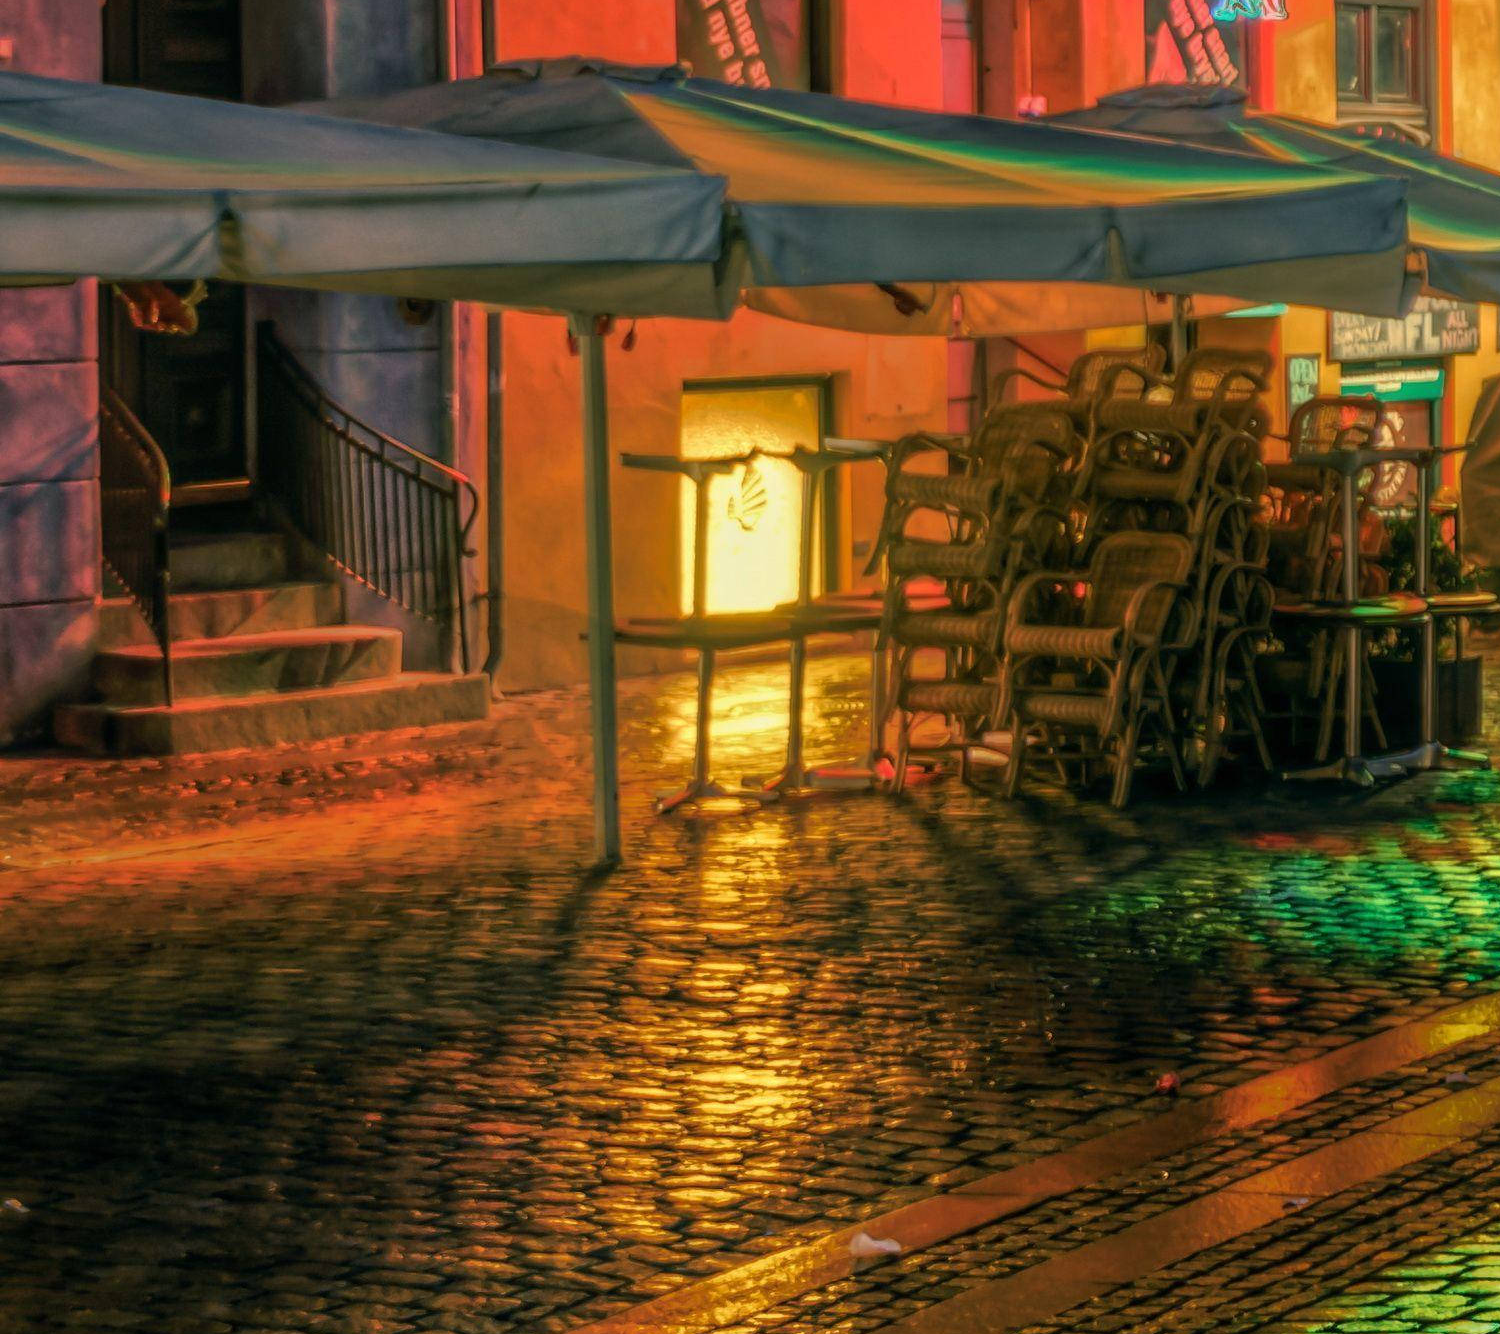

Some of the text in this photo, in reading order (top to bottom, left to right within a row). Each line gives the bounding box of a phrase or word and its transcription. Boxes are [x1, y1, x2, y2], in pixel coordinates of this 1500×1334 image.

[707, 8, 735, 61] nye
[1447, 310, 1469, 328] ALL
[1442, 328, 1478, 350] NIGHT
